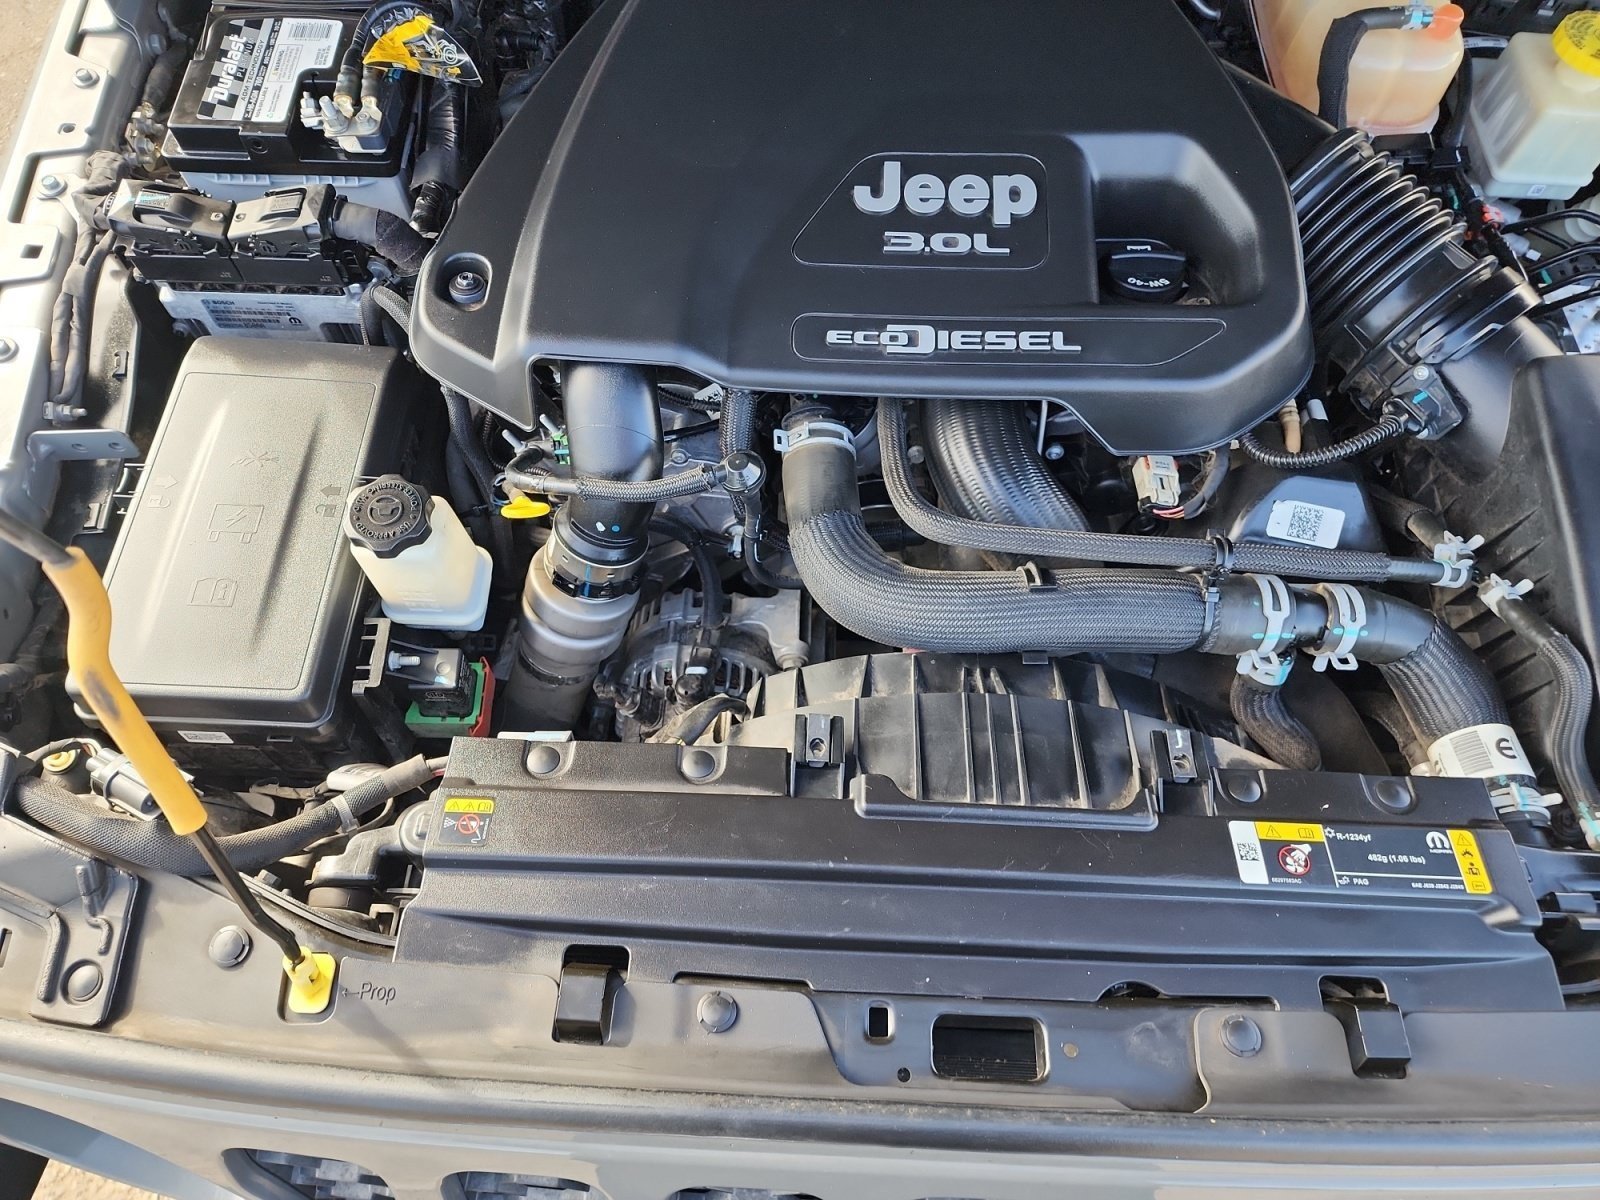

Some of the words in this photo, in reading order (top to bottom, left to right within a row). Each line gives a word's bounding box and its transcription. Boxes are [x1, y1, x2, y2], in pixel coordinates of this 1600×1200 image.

[208, 34, 246, 102] Duralast
[241, 84, 249, 101] AGM
[246, 40, 265, 84] TECHNOLOGY
[853, 161, 1038, 227] Jeep
[883, 231, 1010, 256] 3.0L
[1127, 277, 1170, 288] 5W-40
[403, 486, 420, 512] POWER
[356, 522, 397, 540] APPROVED
[398, 521, 412, 534] USE
[1336, 832, 1372, 843] R-1234yf
[1367, 853, 1388, 864] 482g
[1409, 855, 1426, 865] lbs)
[1352, 878, 1369, 886] PAG
[360, 981, 396, 1006] Prop
